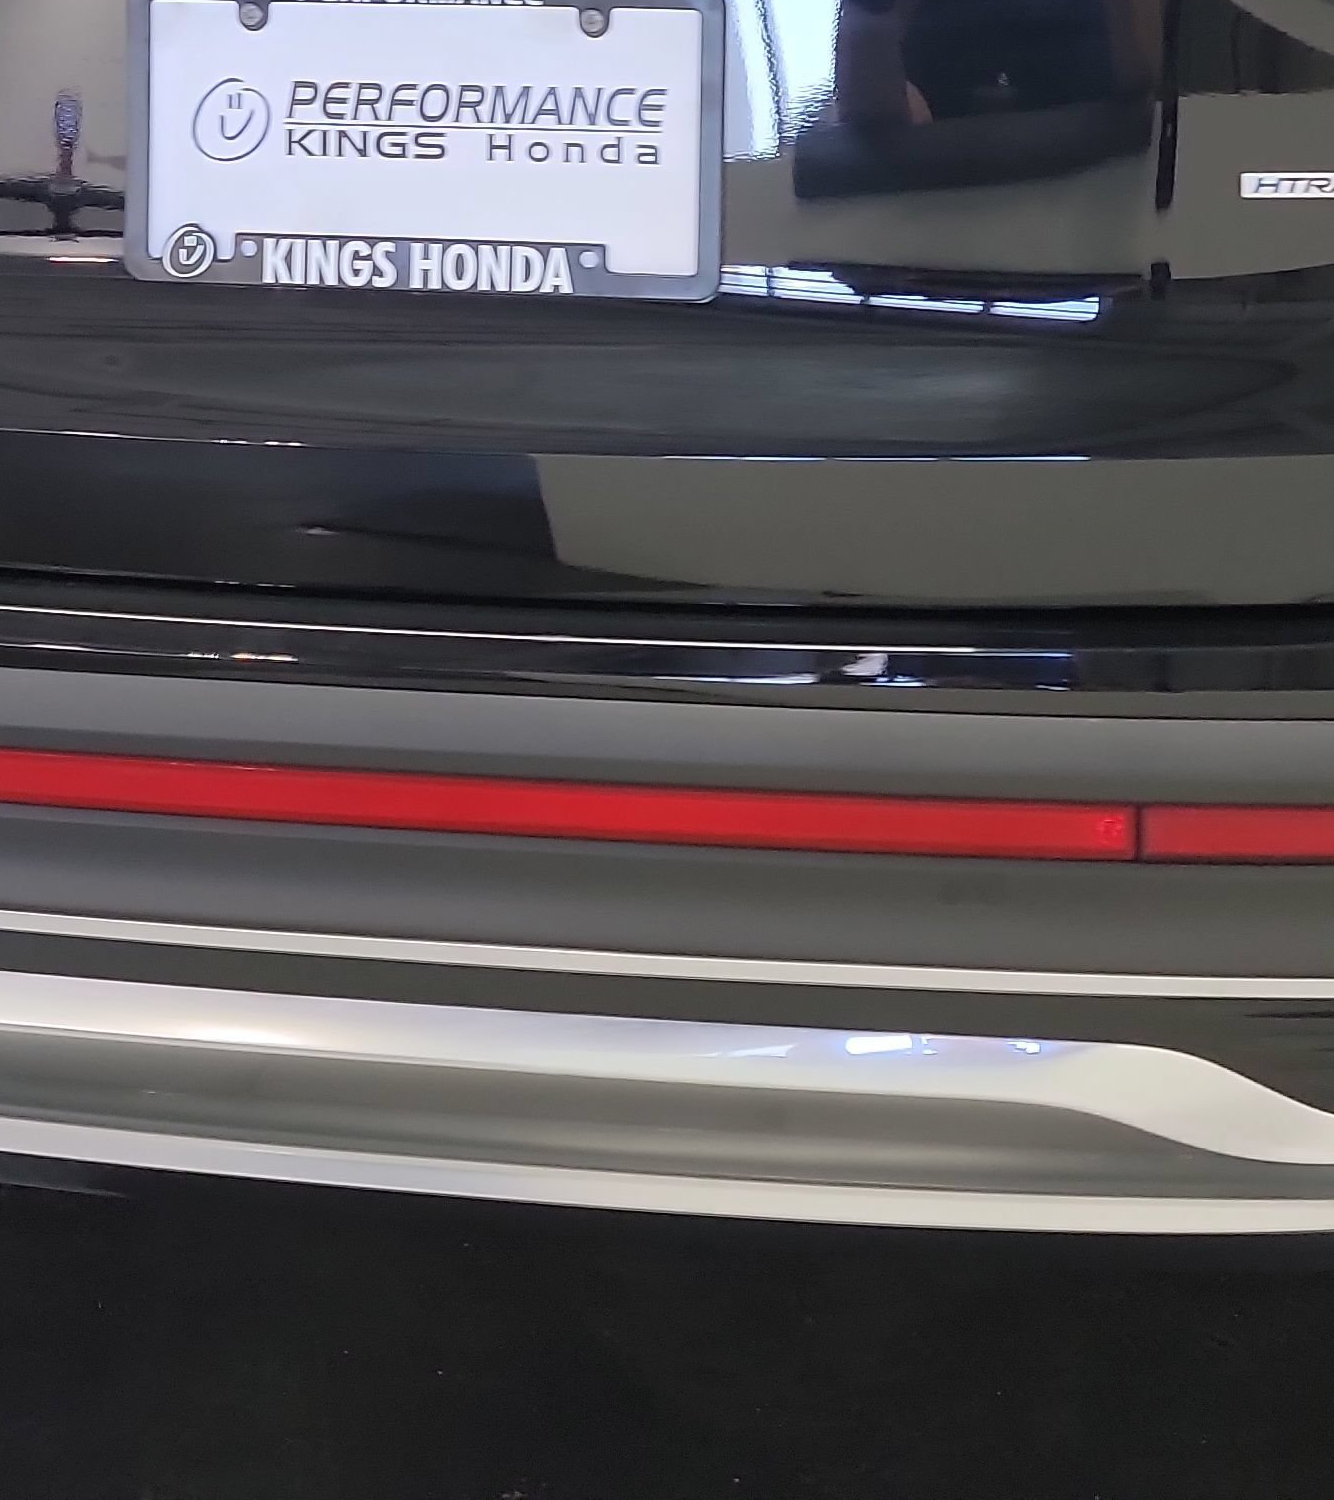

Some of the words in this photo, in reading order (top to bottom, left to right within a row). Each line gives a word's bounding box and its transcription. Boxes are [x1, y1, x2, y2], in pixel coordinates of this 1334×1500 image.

[286, 80, 668, 128] PERFORMANCE
[285, 129, 447, 159] KINGS
[486, 133, 661, 165] Honda
[261, 238, 397, 288] KINGS
[409, 242, 574, 294] HONDA
